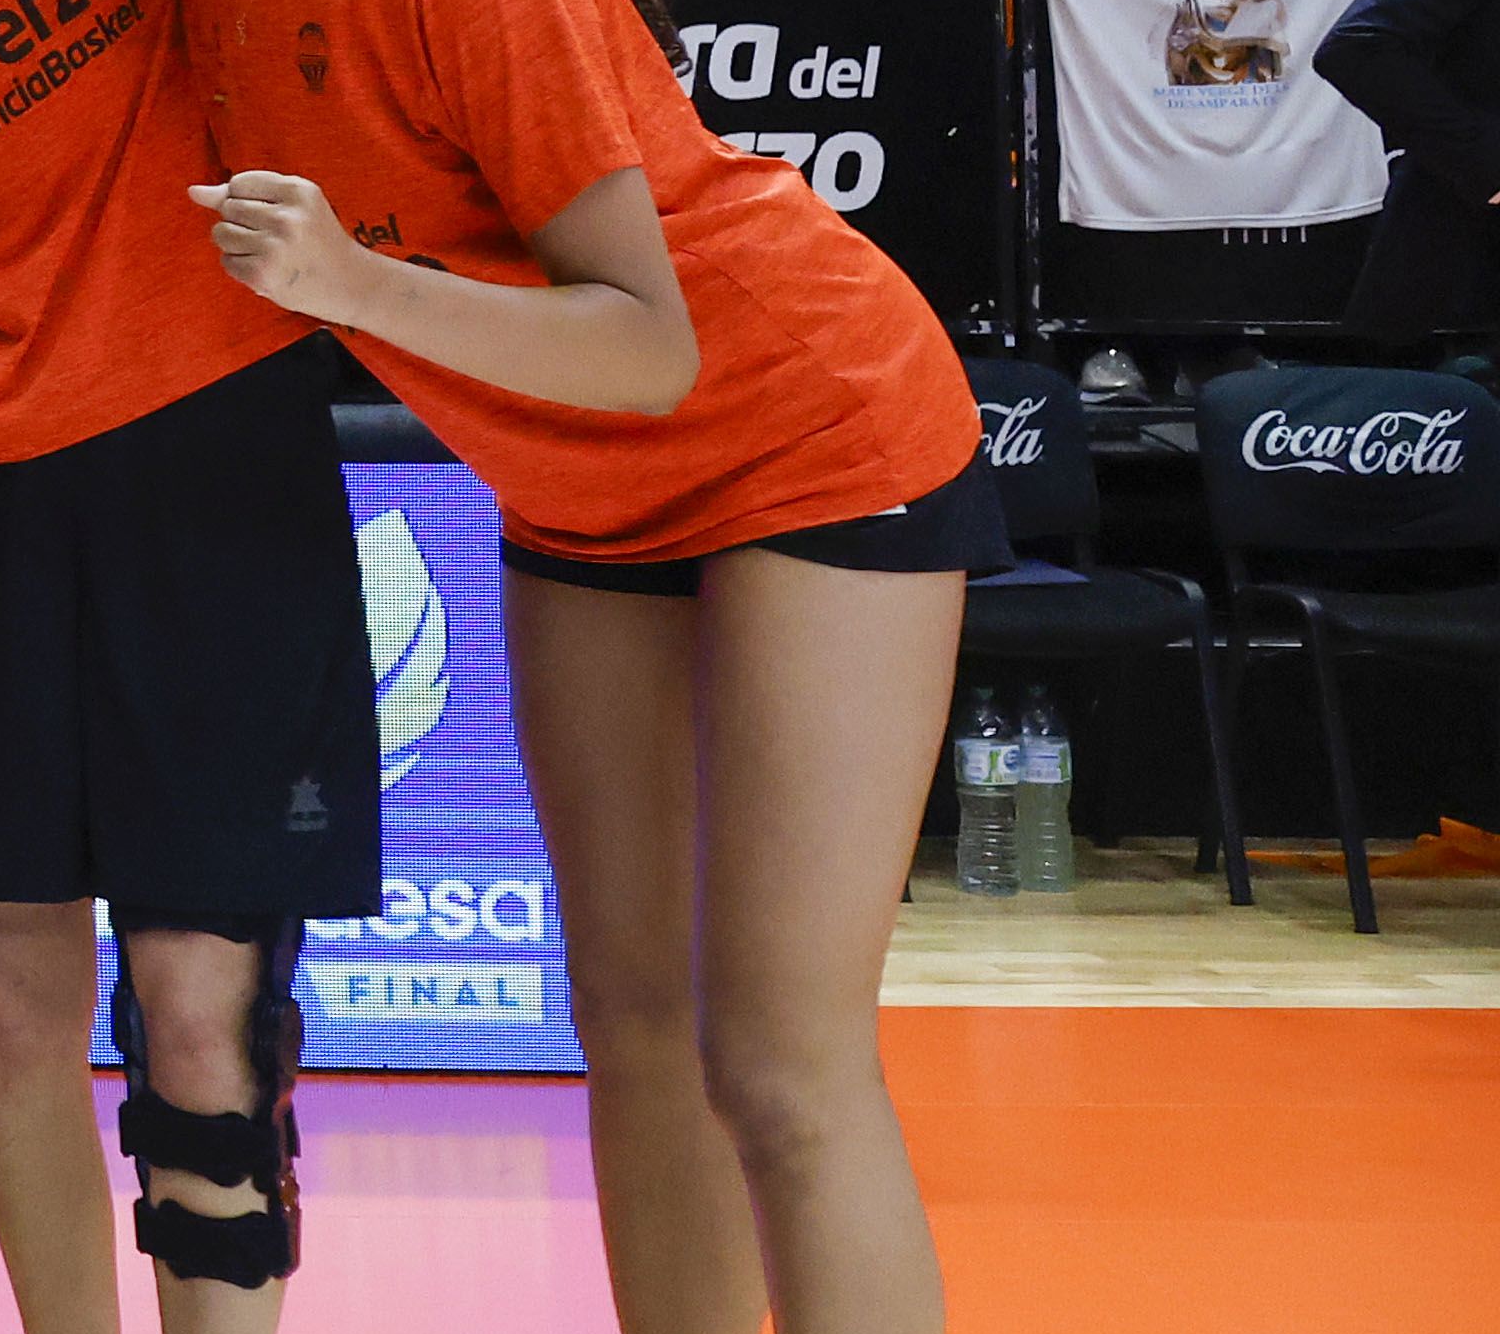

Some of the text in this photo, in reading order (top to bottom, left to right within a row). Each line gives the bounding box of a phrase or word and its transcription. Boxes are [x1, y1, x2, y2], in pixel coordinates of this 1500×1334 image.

[789, 45, 881, 100] del
[354, 212, 403, 248] del
[1242, 407, 1468, 475] Coca-Cola
[346, 976, 522, 1008] FINAL
